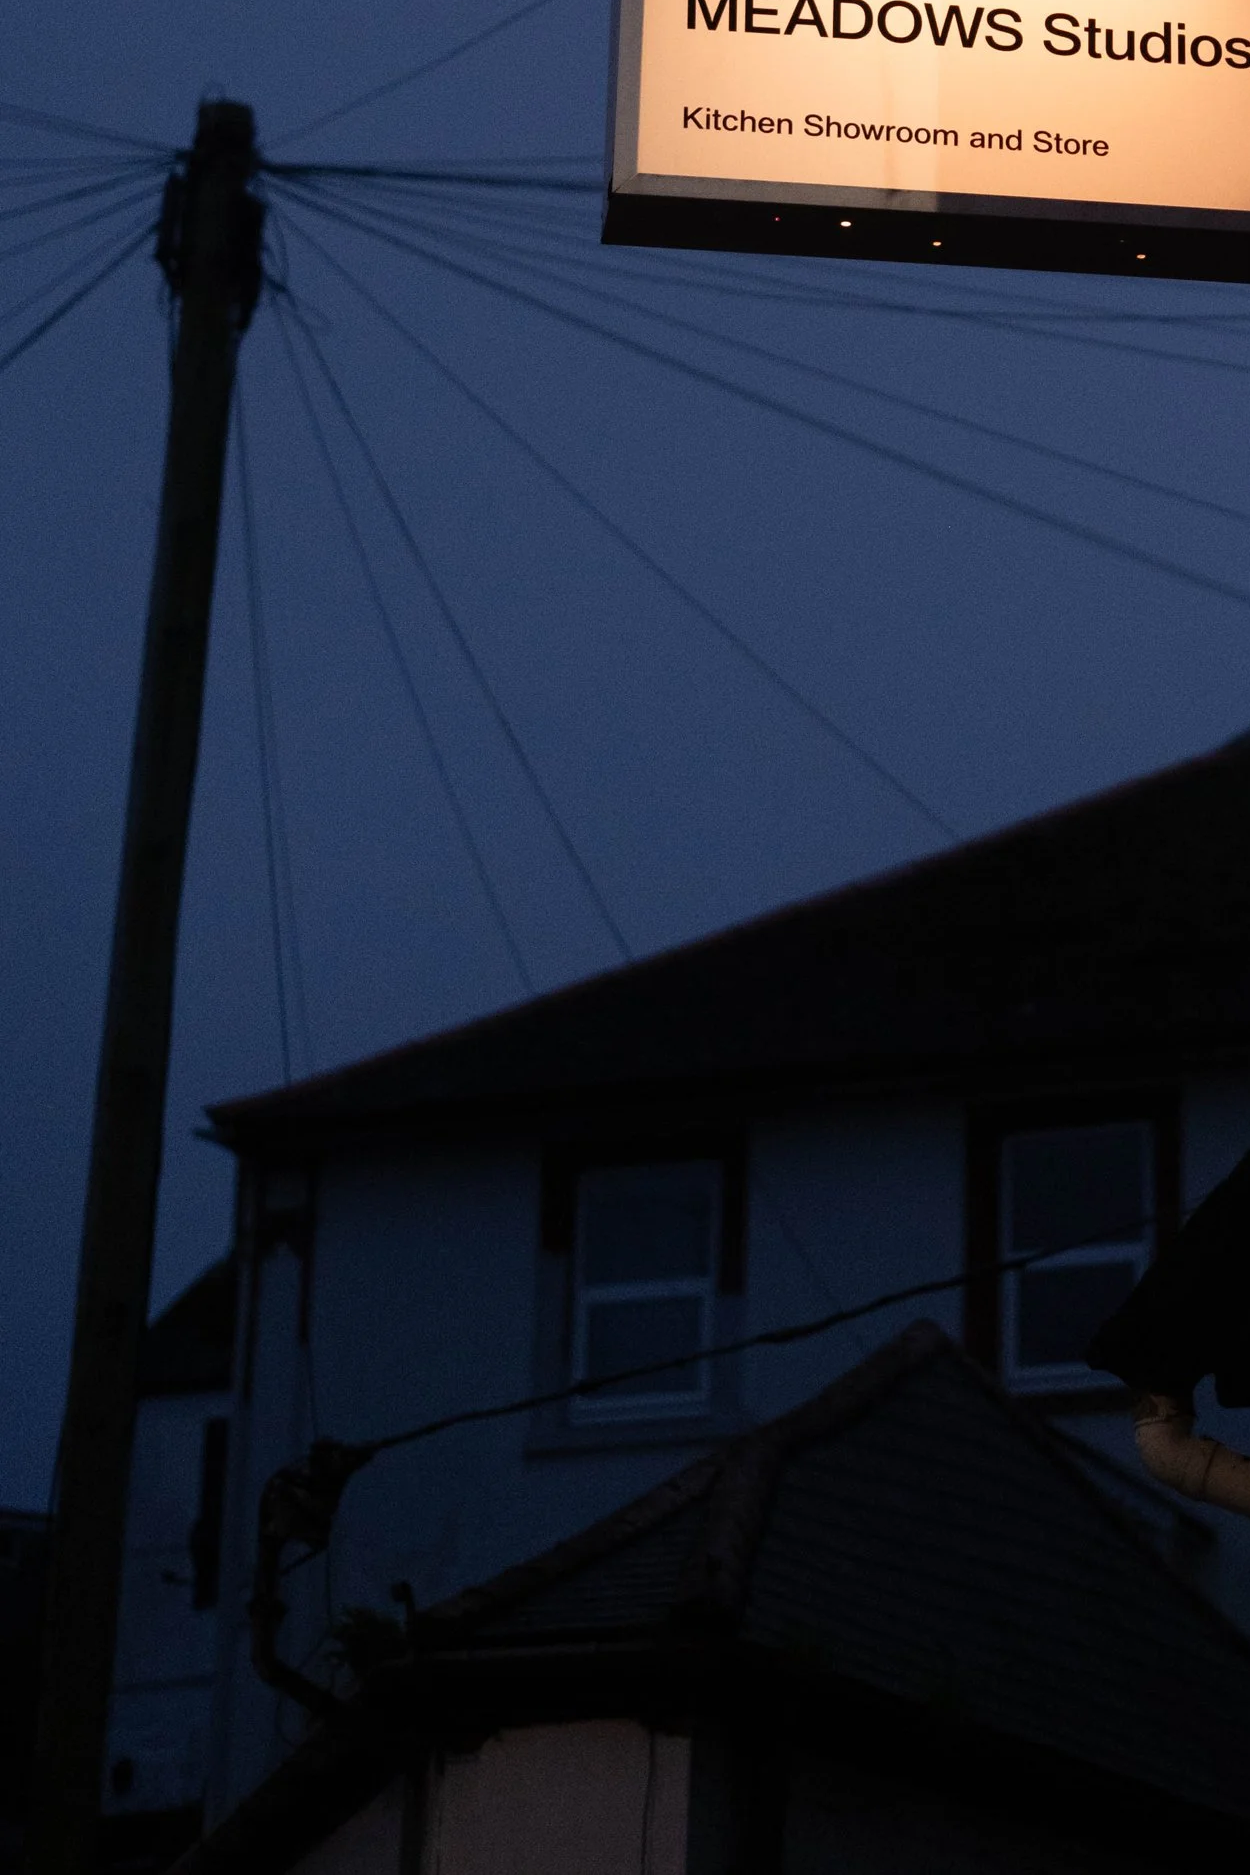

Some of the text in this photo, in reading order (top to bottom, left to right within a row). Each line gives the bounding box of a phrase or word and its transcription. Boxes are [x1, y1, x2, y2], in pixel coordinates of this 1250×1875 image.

[683, 106, 1110, 157] Kitchen Showroom and Store
